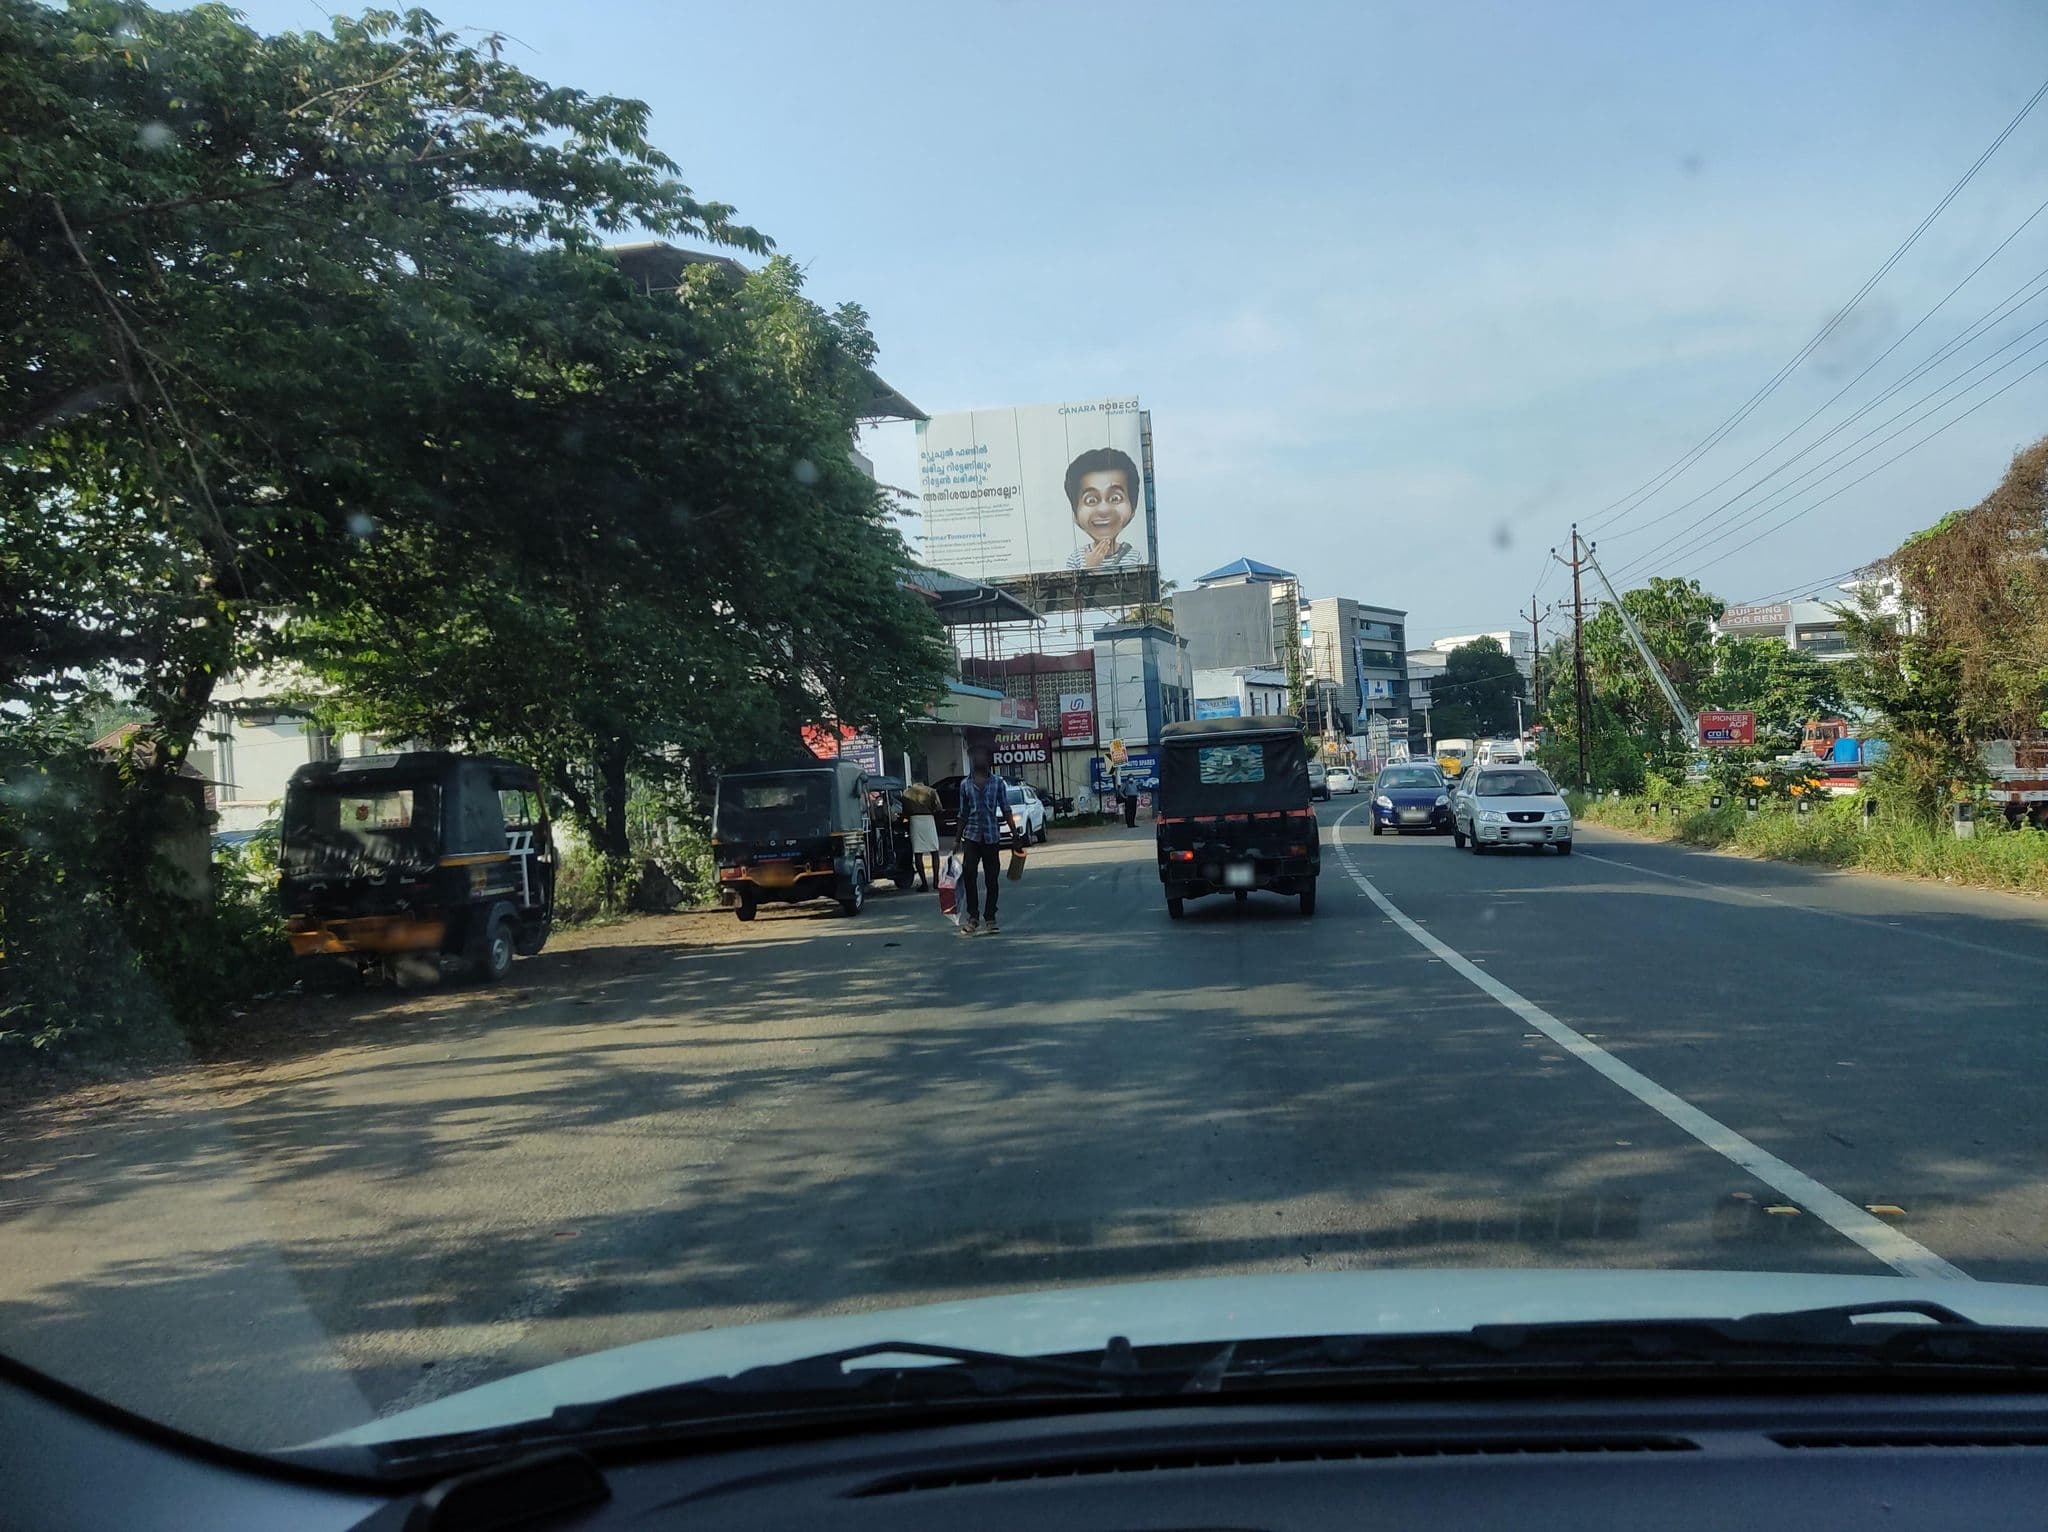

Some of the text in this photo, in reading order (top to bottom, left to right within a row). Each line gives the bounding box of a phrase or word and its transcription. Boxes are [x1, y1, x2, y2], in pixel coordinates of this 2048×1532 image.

[1058, 400, 1139, 415] CANARA ROBECO
[1727, 606, 1781, 617] BUILDING
[1727, 613, 1784, 625] FOR RENT
[994, 731, 1044, 743] Anix Inn
[1707, 728, 1729, 737] craft
[993, 749, 1046, 764] ROOMS
